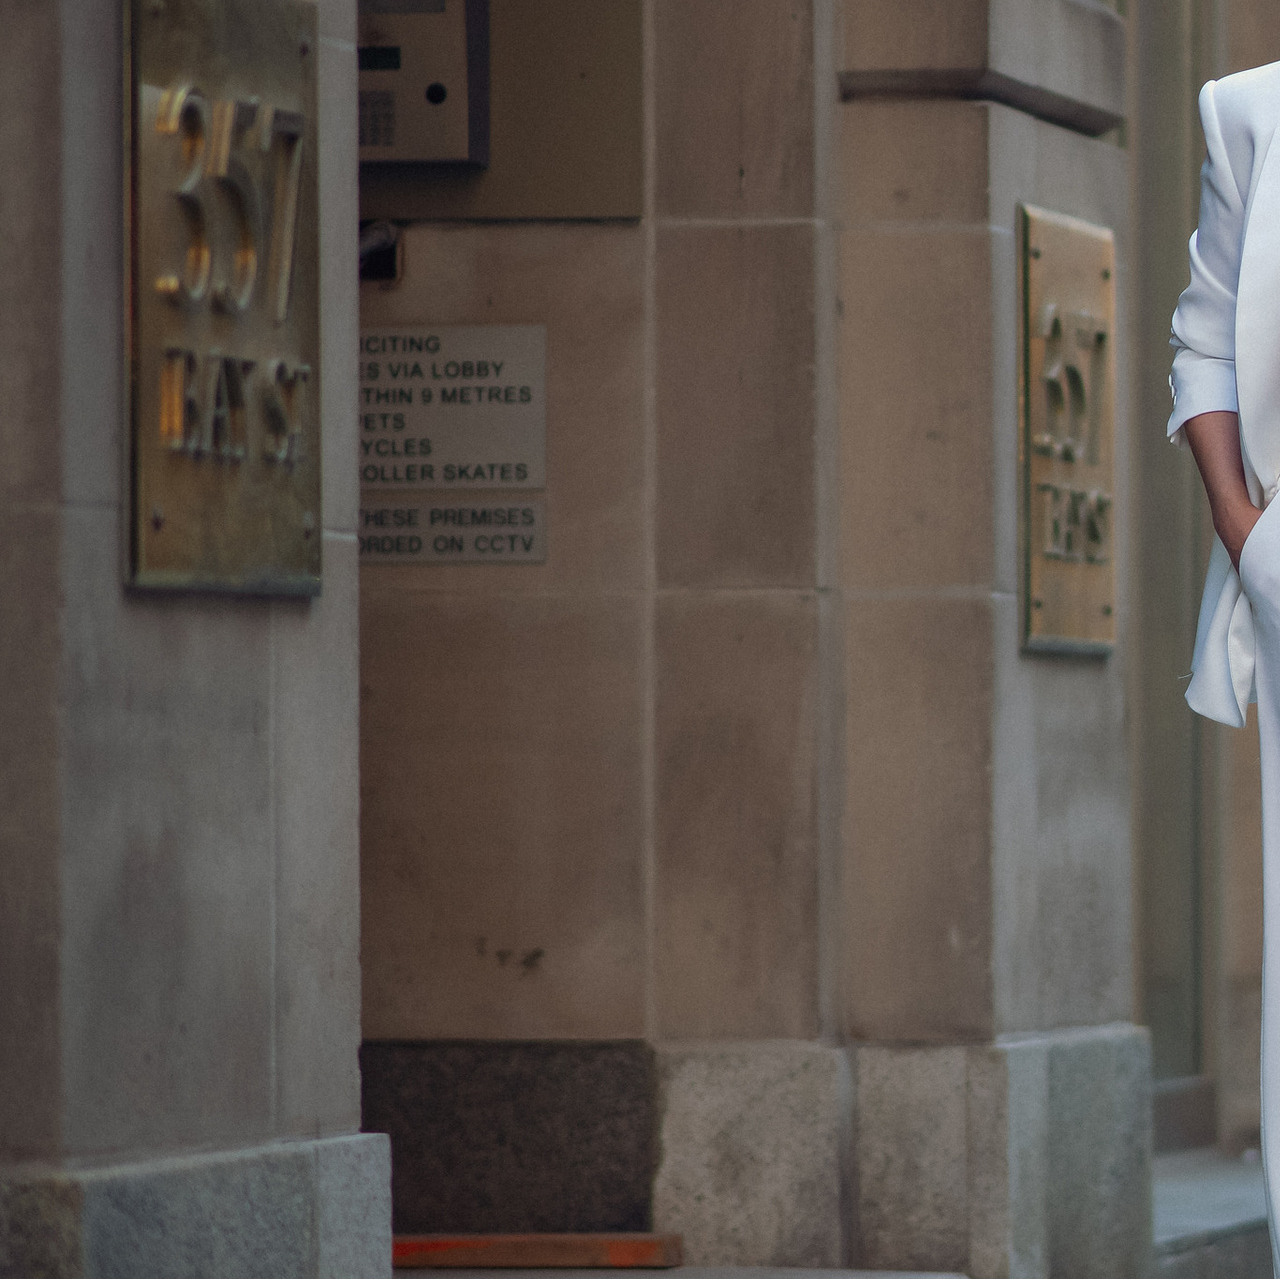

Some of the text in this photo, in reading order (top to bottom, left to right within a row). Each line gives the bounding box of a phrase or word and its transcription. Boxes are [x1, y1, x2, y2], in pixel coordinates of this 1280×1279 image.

[154, 83, 305, 327] 357
[388, 361, 424, 379] VIA
[432, 360, 504, 380] LOBBY
[421, 387, 433, 404] 9
[441, 385, 532, 405] METRES
[360, 413, 406, 432] ETS
[443, 463, 529, 482] SKATES
[430, 507, 535, 528] PREMISES
[433, 535, 464, 553] ON
[474, 534, 535, 553] CCTV
